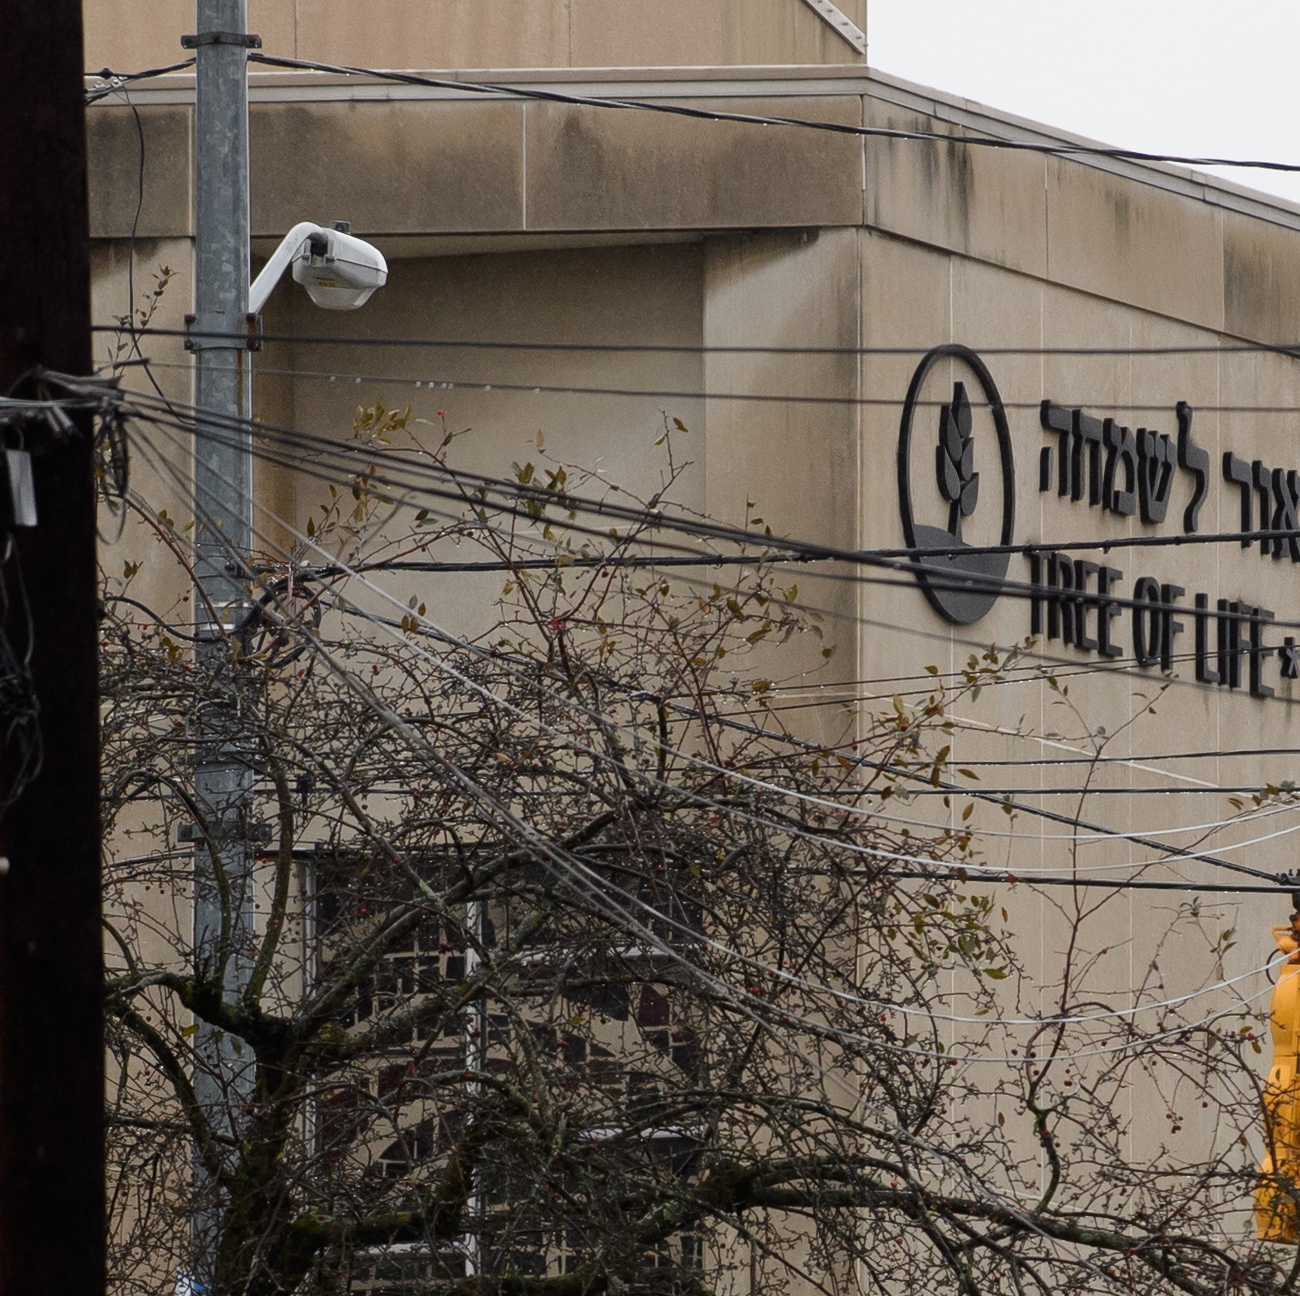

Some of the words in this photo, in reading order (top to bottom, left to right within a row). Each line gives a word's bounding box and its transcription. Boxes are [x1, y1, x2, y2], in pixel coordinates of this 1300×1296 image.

[1040, 399, 1210, 533] לשמחה
[1028, 550, 1124, 658] TREE
[1133, 576, 1185, 671] OF
[1196, 593, 1275, 699] LIFE
